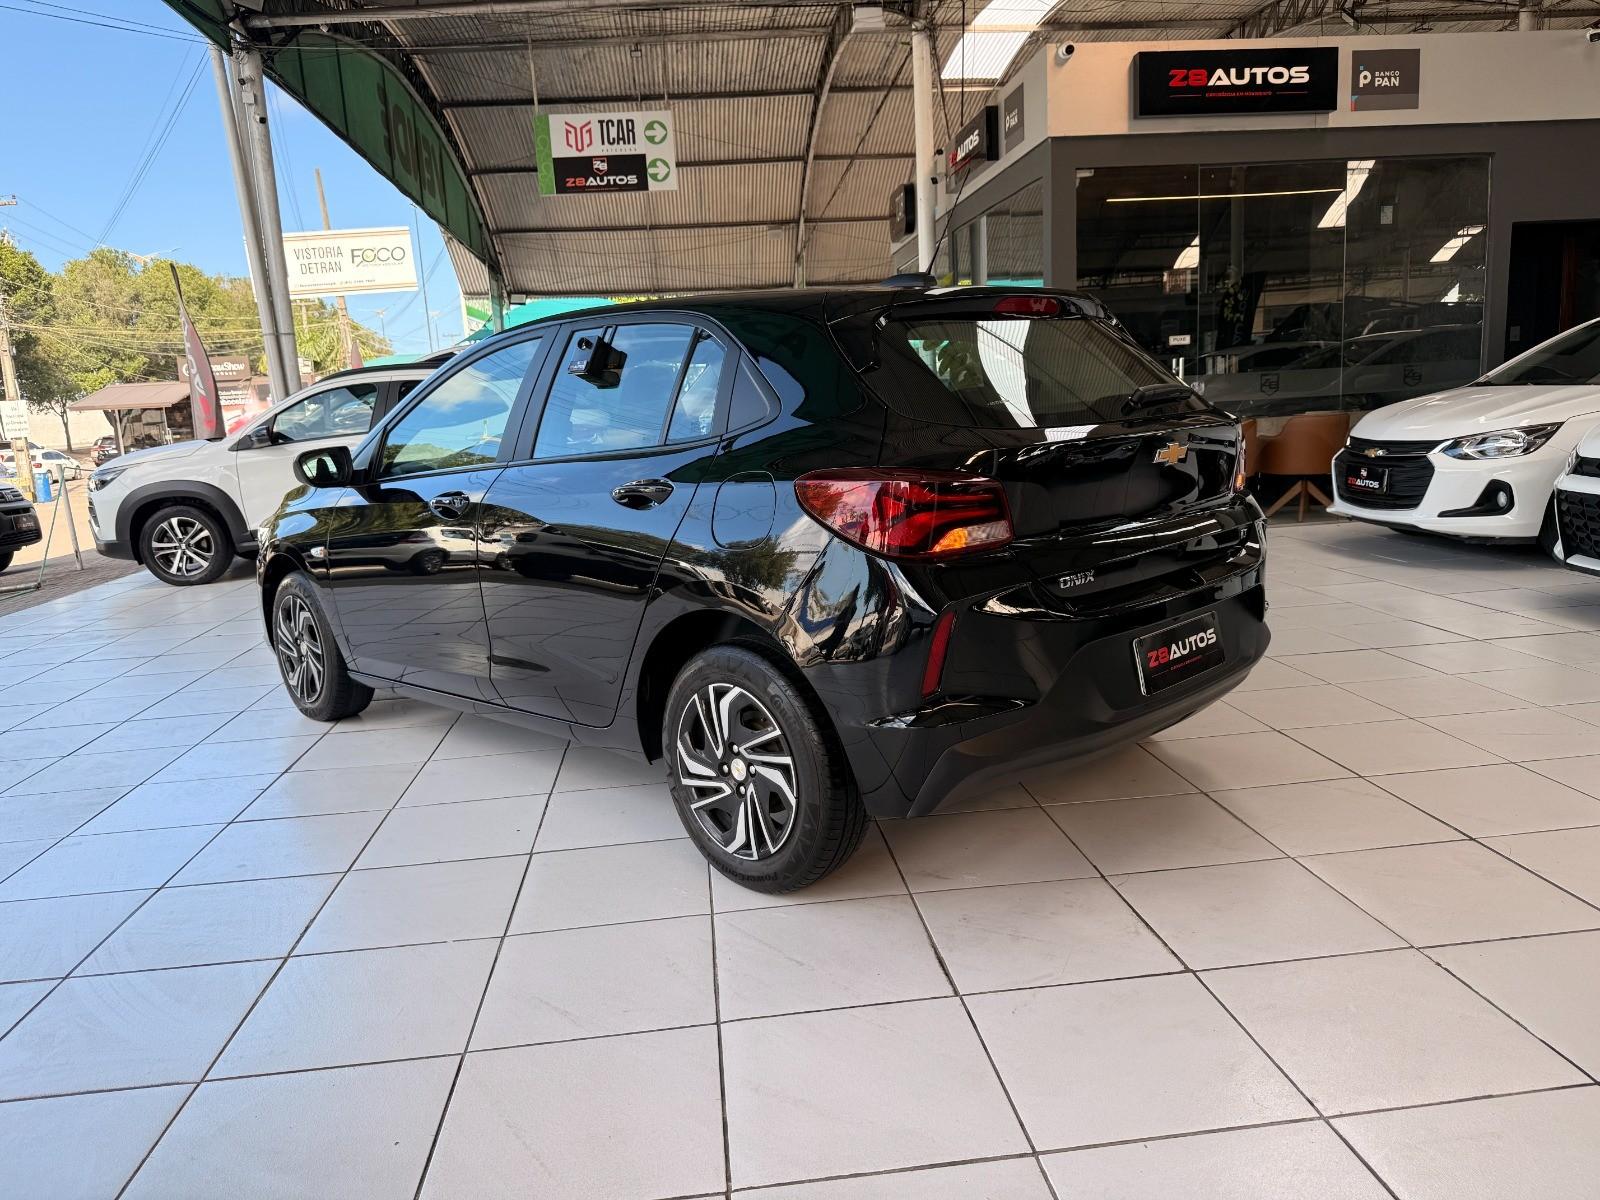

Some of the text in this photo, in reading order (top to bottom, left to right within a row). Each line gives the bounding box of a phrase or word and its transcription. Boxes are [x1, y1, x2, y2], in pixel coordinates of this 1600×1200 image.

[1168, 66, 1310, 87] Z8AUTOS
[1374, 76, 1400, 88] PAN
[598, 119, 636, 146] TCAR
[565, 175, 638, 187] Z8AUTOS
[294, 246, 344, 260] VISTORIA
[351, 246, 406, 268] FOCO
[300, 261, 342, 275] DETRAN
[1059, 569, 1095, 589] ONIX
[1147, 628, 1217, 668] Z8AUTOS
